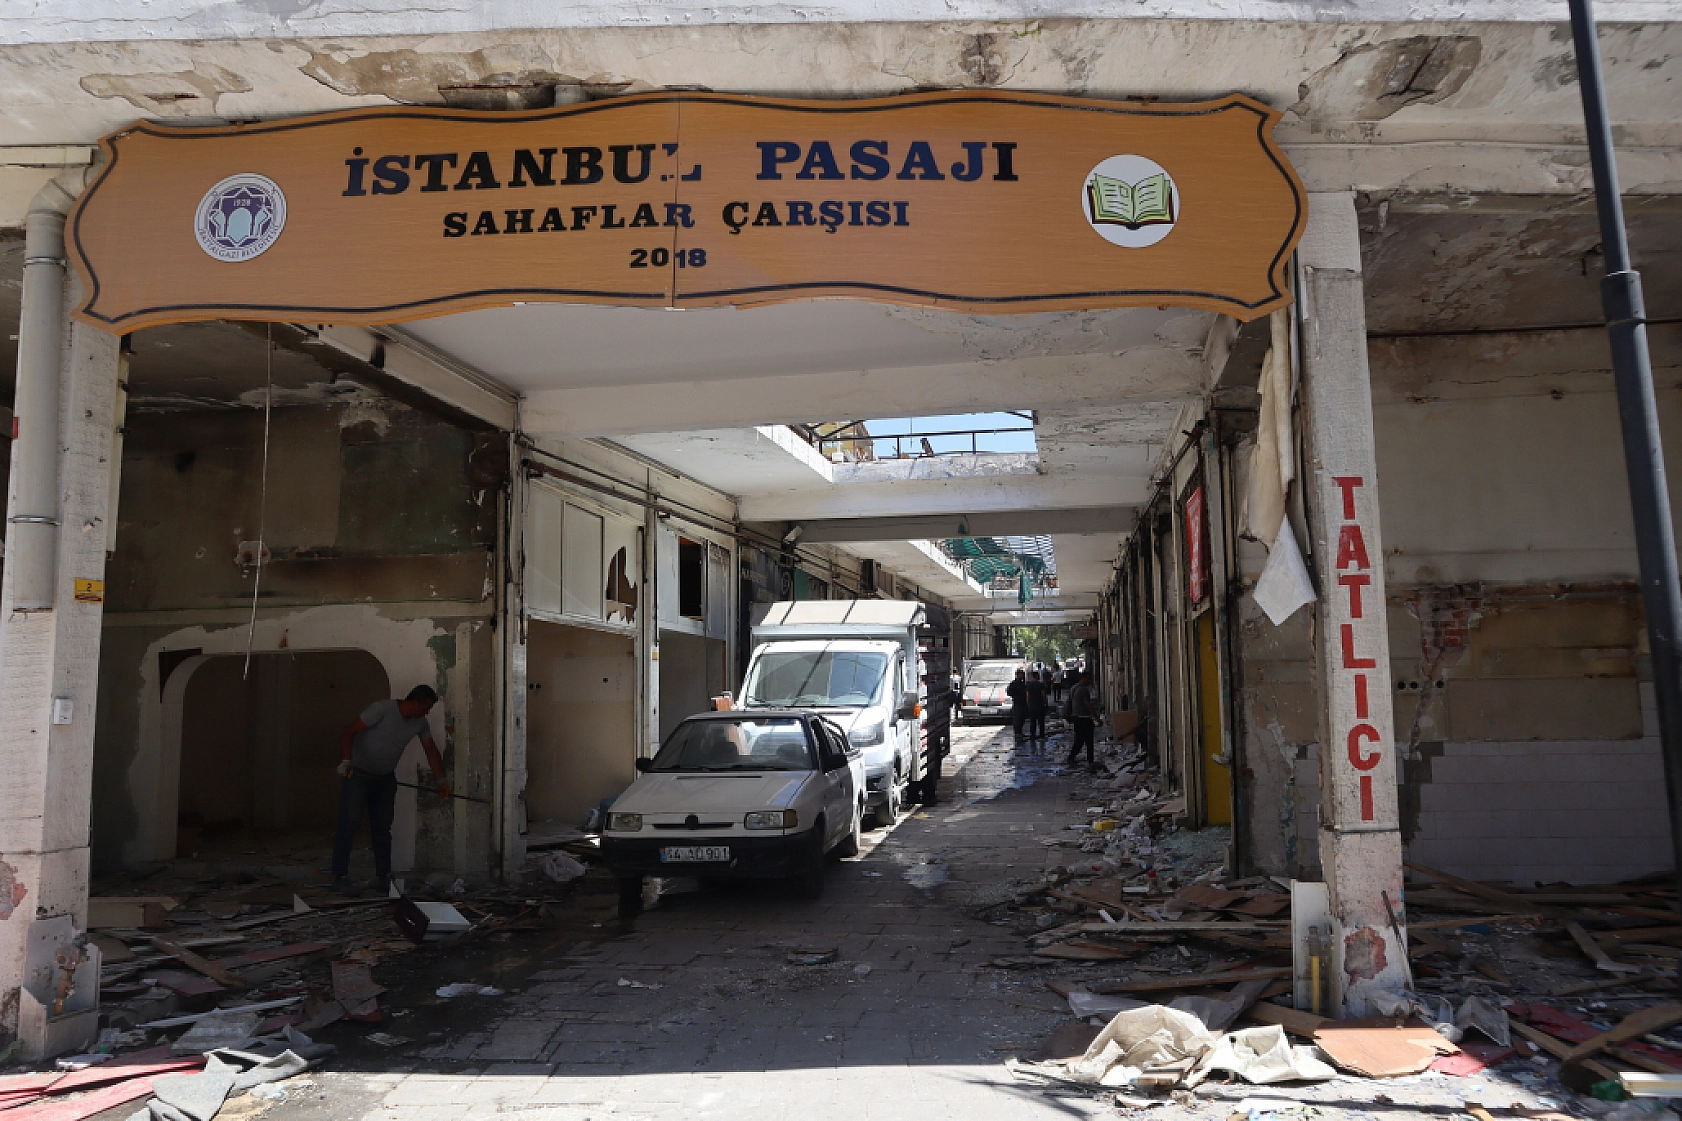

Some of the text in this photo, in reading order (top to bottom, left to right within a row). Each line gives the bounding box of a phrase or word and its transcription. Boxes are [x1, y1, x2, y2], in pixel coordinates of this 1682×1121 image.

[756, 140, 1019, 182] PASAJI
[443, 200, 910, 238] SAHAFLAR ÇARŞISI
[629, 247, 707, 268] 2018
[1331, 476, 1381, 821] TATLICI
